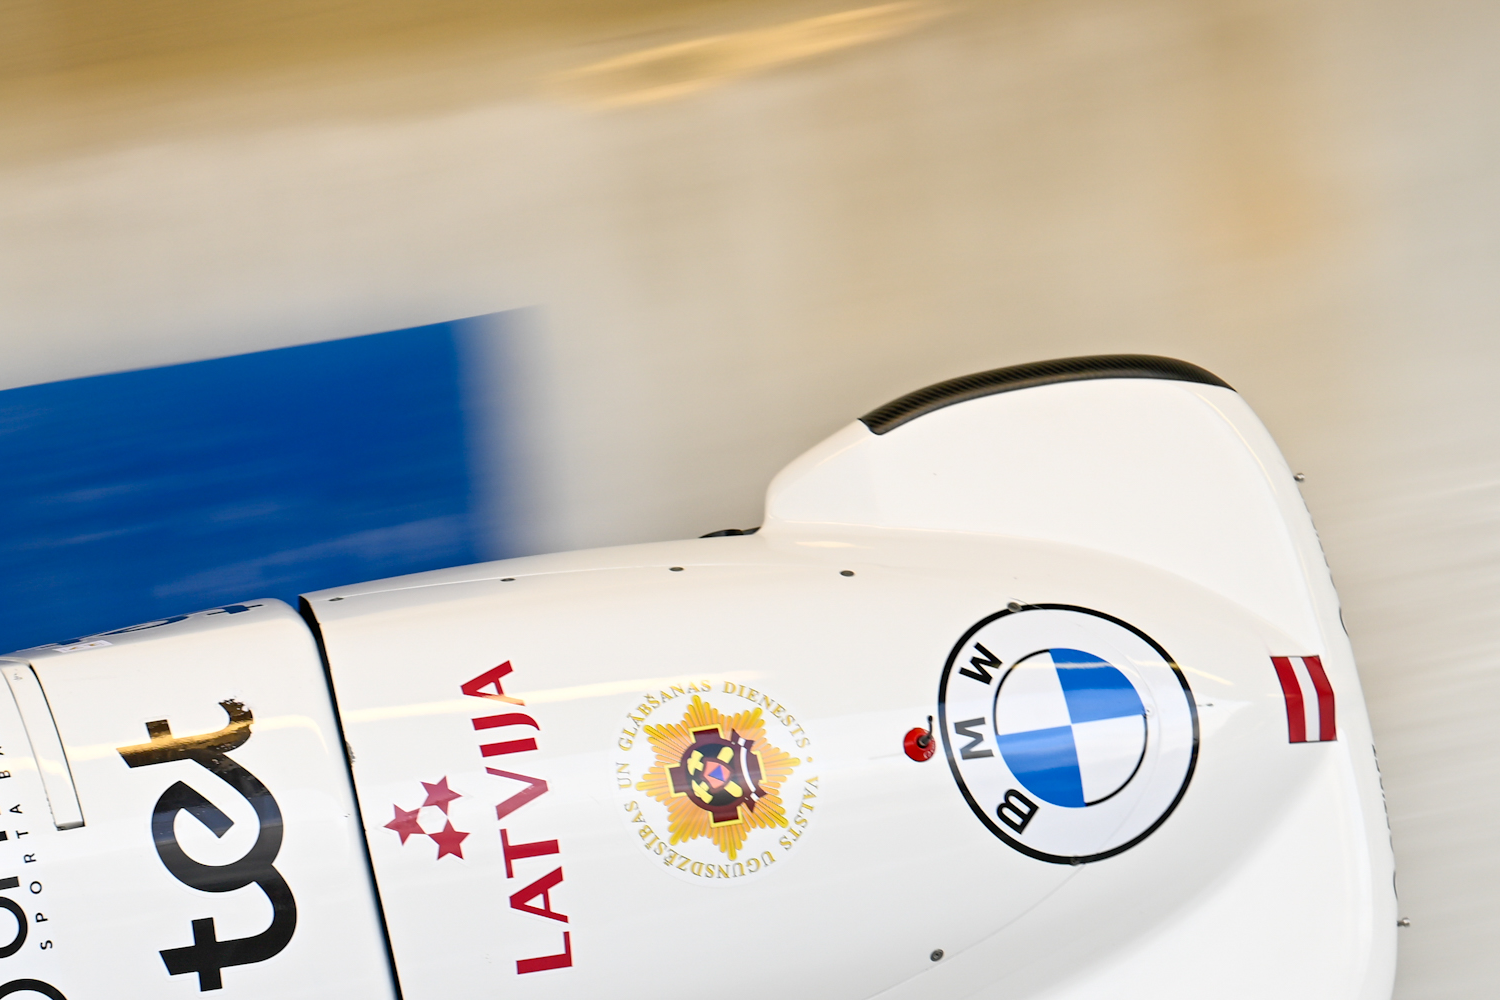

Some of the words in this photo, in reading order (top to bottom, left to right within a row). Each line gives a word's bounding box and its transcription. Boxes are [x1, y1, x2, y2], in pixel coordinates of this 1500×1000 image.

[617, 679, 713, 752] GLĀBŠANAS
[721, 680, 811, 749] DIENESTS
[953, 641, 1040, 835] BMW
[459, 659, 574, 976] LATVIJA
[615, 761, 633, 790] UN
[778, 775, 819, 851] VALSTS
[8, 802, 54, 951] SPORTA
[116, 696, 298, 993] tet
